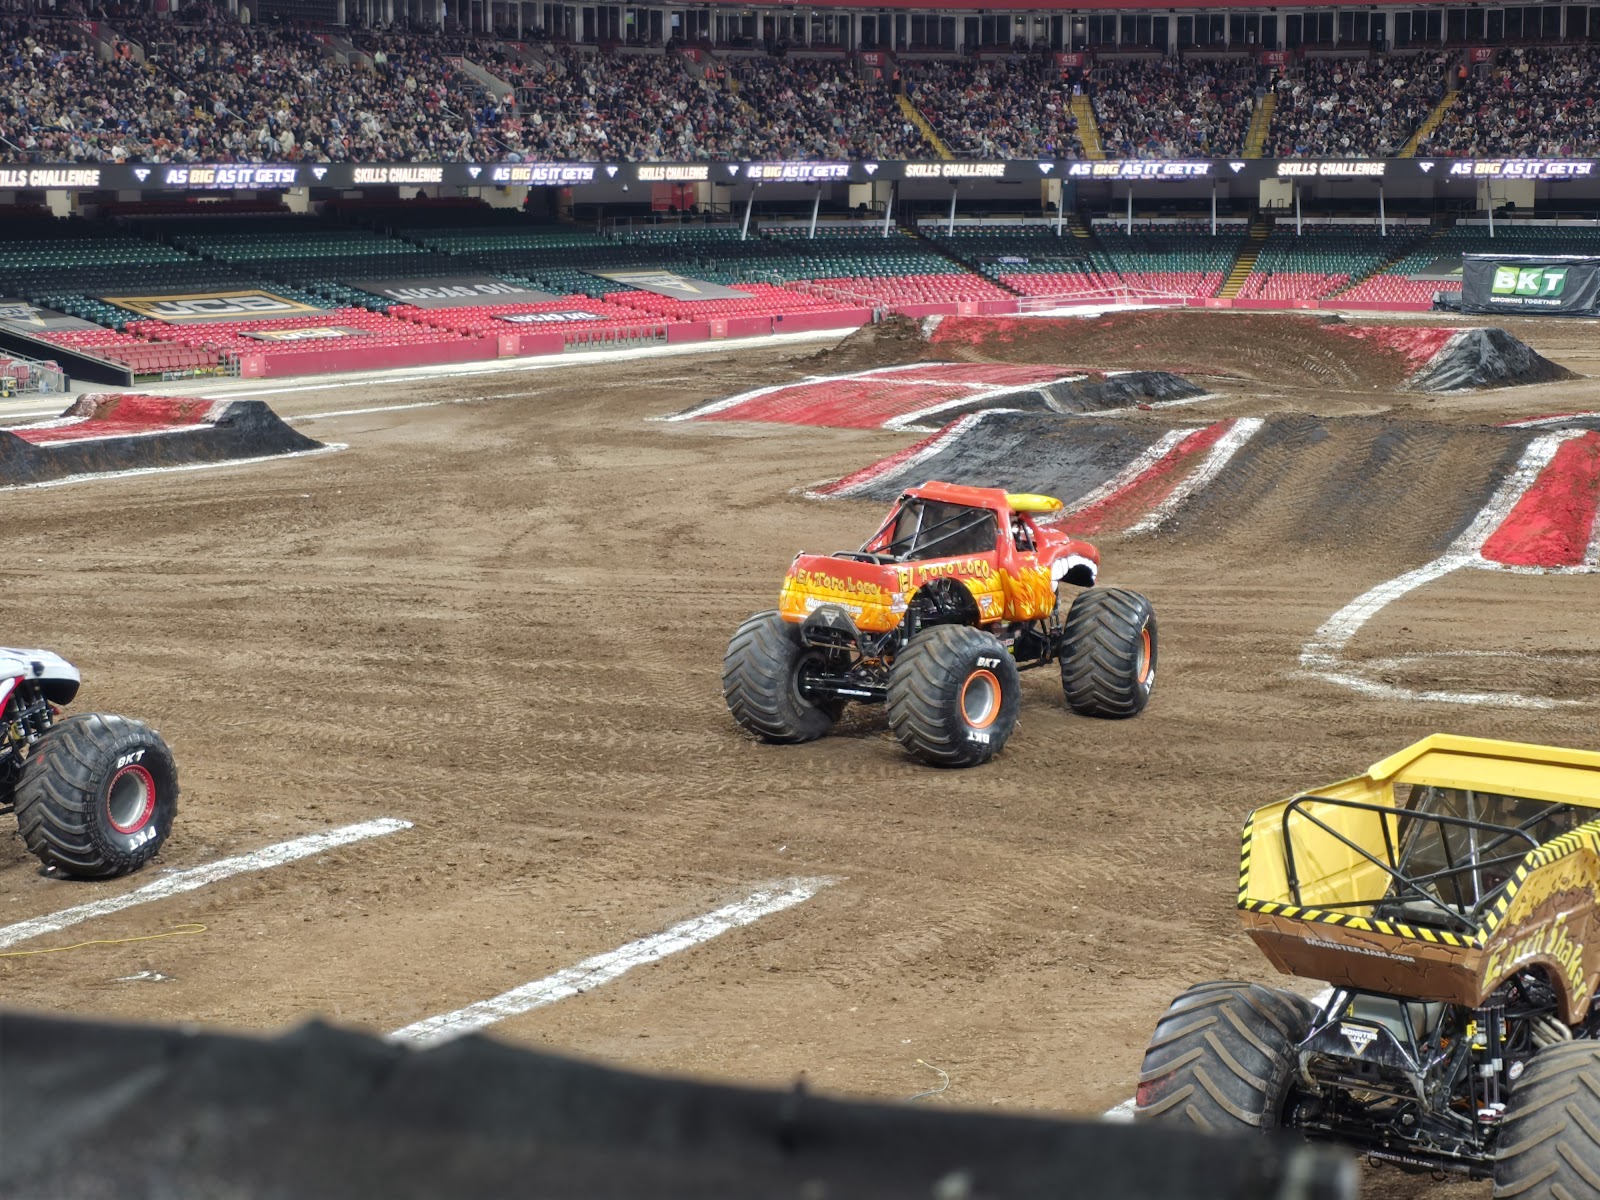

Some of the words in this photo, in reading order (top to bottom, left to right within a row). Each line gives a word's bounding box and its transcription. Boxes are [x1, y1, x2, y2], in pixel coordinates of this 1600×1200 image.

[494, 167, 510, 181] AS
[511, 167, 530, 181] BIG
[532, 167, 549, 181] AS
[549, 167, 562, 181] IT
[562, 167, 594, 181] GETS!
[638, 166, 665, 180] SKILLS
[665, 166, 708, 180] CHALLENGE
[748, 165, 762, 178] AS
[763, 165, 781, 178] BIG
[783, 165, 798, 178] AS
[799, 165, 812, 178] IT
[813, 165, 848, 178] GETS!
[905, 163, 941, 178] SKILLS
[943, 163, 1005, 177] CHALLENGE
[1069, 163, 1092, 176] AS
[1093, 163, 1119, 176] BIG
[1121, 163, 1142, 176] AS
[1144, 163, 1161, 176] IT
[1163, 163, 1209, 176] GETS!
[1277, 162, 1317, 176] SKILLS
[1319, 162, 1385, 175] CHALLENGE
[1451, 161, 1472, 175] AS
[1474, 161, 1500, 175] BIG
[1503, 161, 1525, 175] AS
[1526, 161, 1543, 175] IT
[1546, 161, 1592, 175] GETS!
[0, 170, 27, 187] ILLS
[30, 170, 100, 187] CHALLENGE
[166, 169, 188, 184] AS
[189, 169, 214, 184] BIG
[216, 169, 236, 184] AS
[237, 169, 252, 184] IT
[255, 169, 296, 184] GETS!
[354, 168, 387, 183] SKILLS
[388, 168, 443, 182] CHALLENGE
[1494, 272, 1564, 291] BKT
[385, 286, 475, 300] LUCAS
[474, 282, 526, 297] OIL
[151, 297, 292, 315] JCB
[1524, 298, 1561, 306] TOGETHER
[279, 329, 343, 340] JCB
[796, 568, 811, 586] El
[814, 572, 844, 591] Toro
[976, 656, 1001, 668] BKT
[967, 731, 990, 744] BKT
[117, 750, 145, 769] BKT
[129, 826, 157, 851] BKT
[1341, 1028, 1378, 1041] MONSTER
